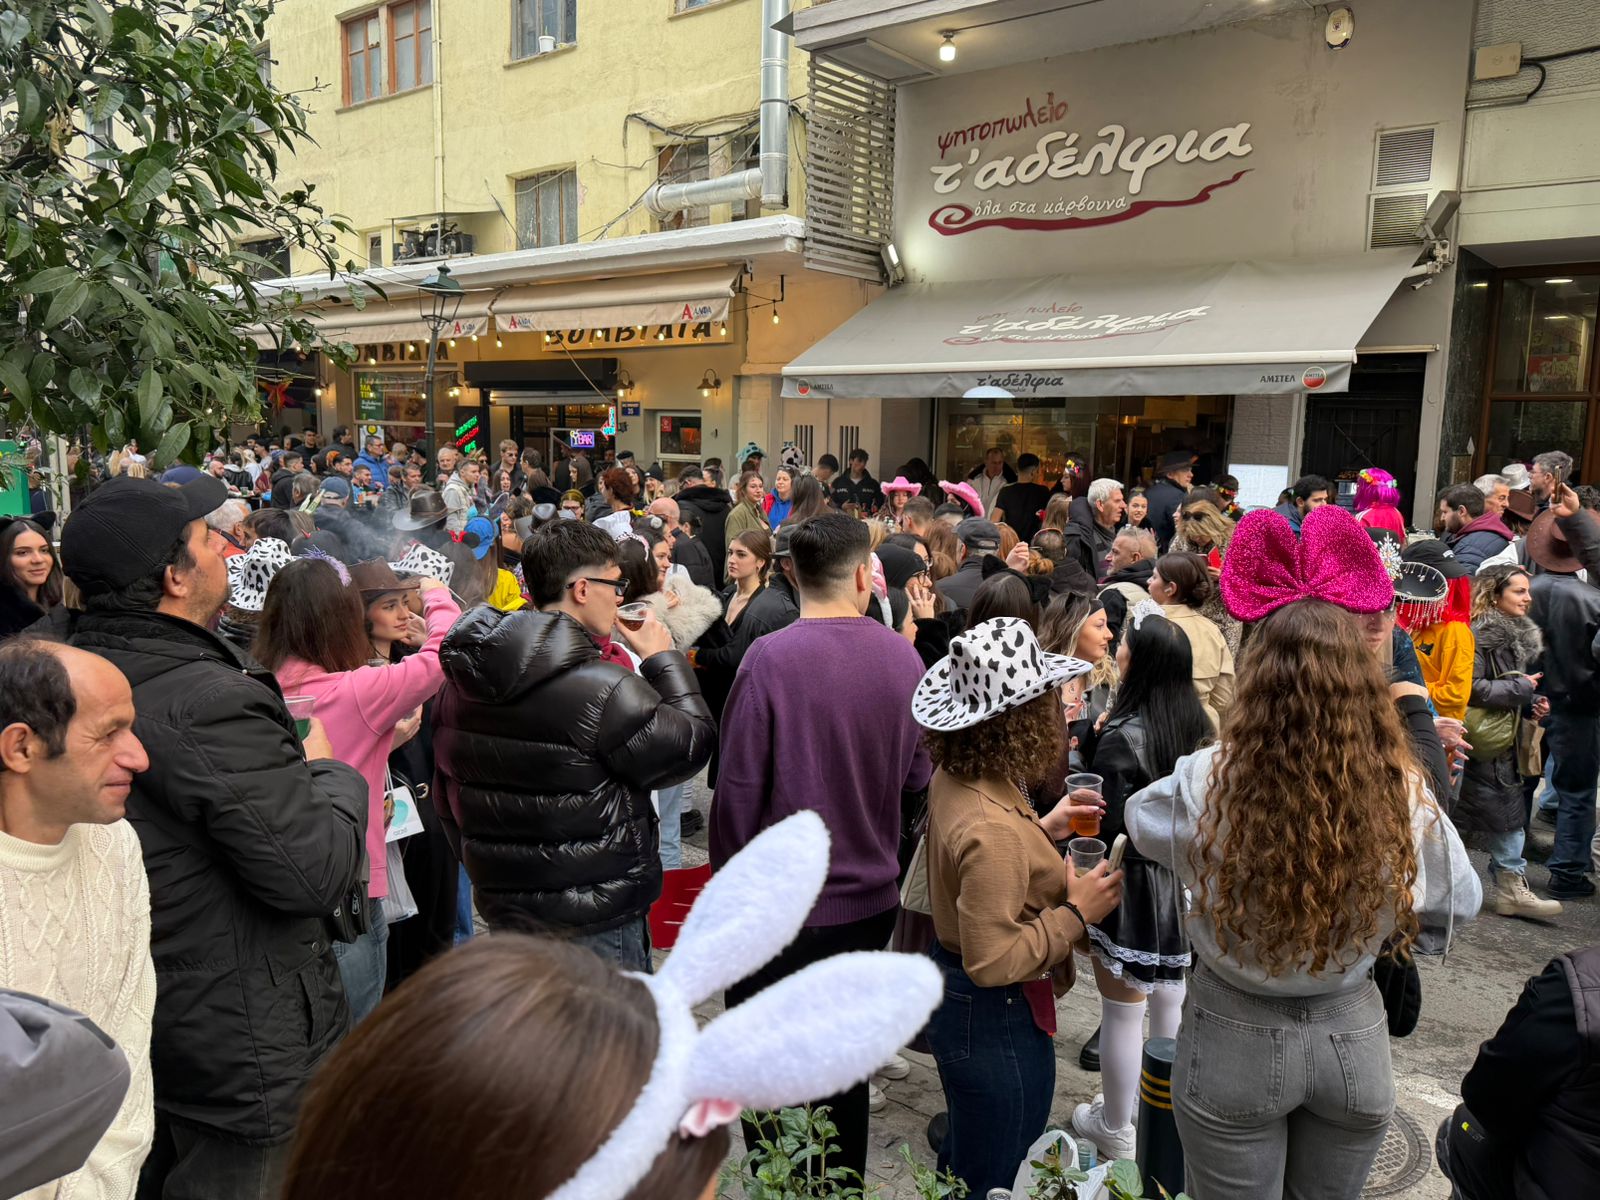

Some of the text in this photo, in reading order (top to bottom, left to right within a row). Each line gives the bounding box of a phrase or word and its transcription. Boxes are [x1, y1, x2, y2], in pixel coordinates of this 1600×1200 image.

[937, 91, 1069, 160] ψητοπωλείο
[974, 195, 1127, 216] όλα στα κάρβουνα
[1260, 375, 1296, 383] ΑΜΣΤΕΛ
[578, 434, 593, 445] BAR
